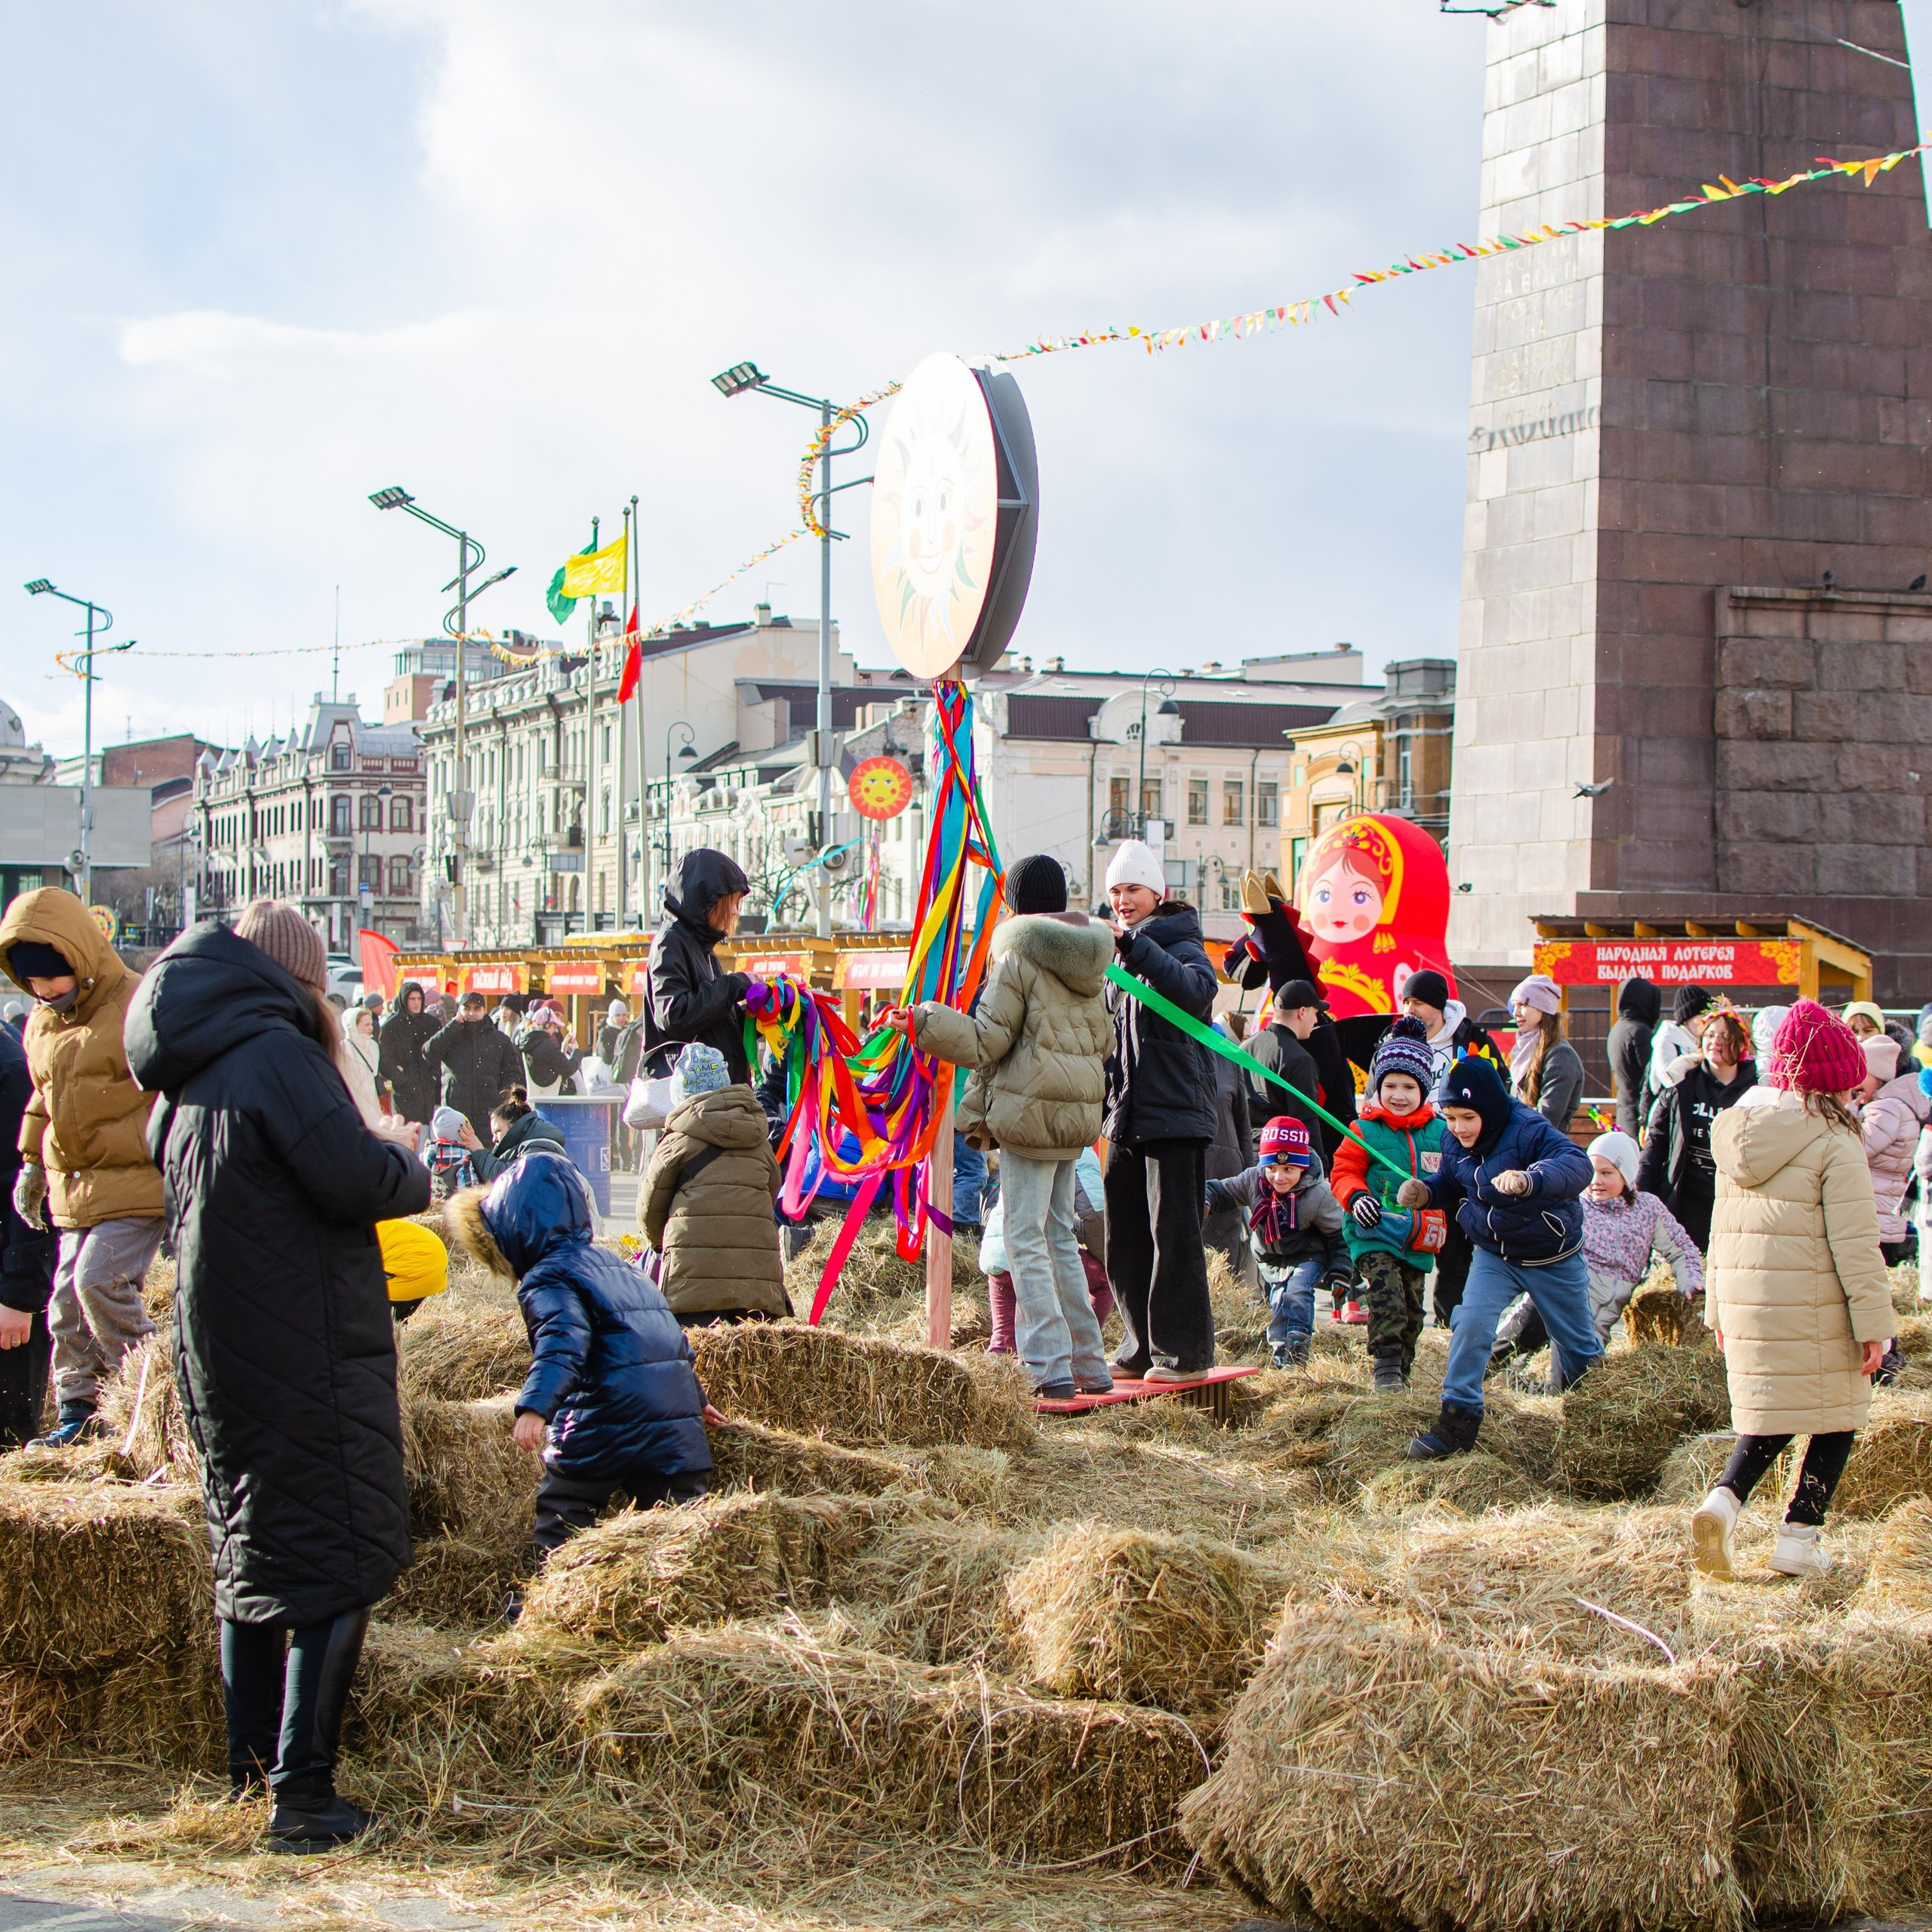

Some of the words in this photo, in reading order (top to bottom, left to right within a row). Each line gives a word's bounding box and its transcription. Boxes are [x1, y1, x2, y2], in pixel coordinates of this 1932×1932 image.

[1494, 279, 1513, 300] ЗА
[1521, 260, 1579, 293] ВЛАСТЬ
[1501, 286, 1574, 322] СОВЕТОВ
[1526, 318, 1546, 341] НА
[1499, 337, 1572, 374] ДАЛЬНЕМ
[1499, 361, 1570, 396] ВОСТОКЕ
[1596, 946, 1667, 963] НАРОДНАЯ
[1674, 946, 1734, 961] ЛОТЕРЕЯ
[1598, 964, 1654, 981] ВЫДАЧА
[1662, 964, 1733, 981] ПОДАРКОВ
[1261, 1129, 1309, 1145] RUSSIA
